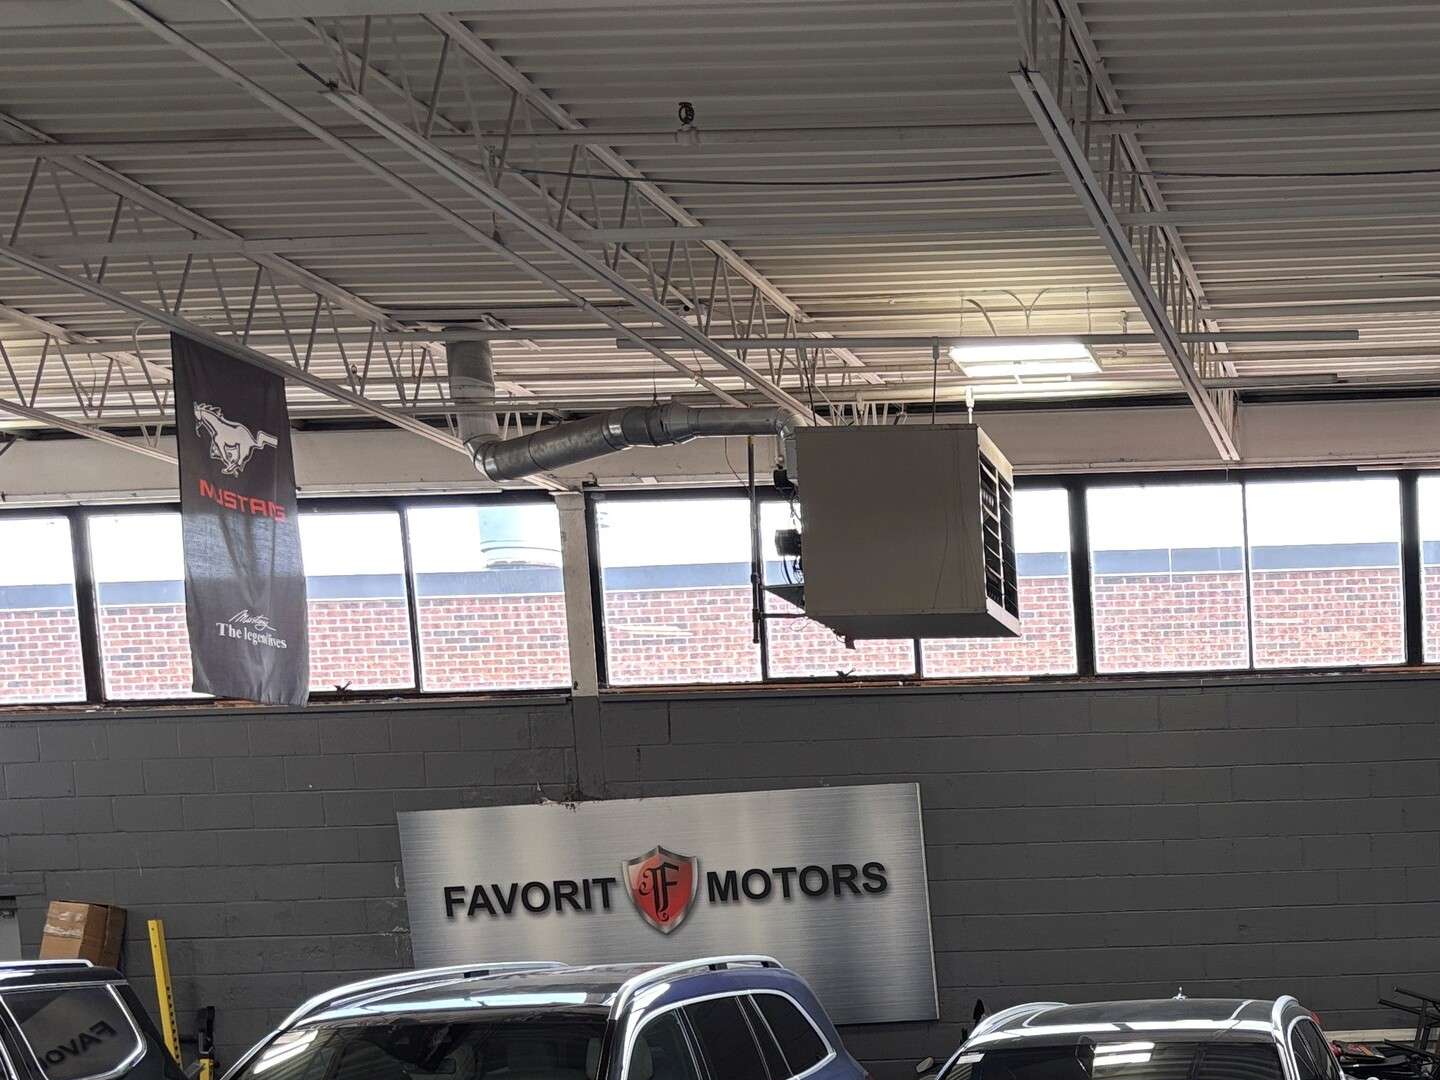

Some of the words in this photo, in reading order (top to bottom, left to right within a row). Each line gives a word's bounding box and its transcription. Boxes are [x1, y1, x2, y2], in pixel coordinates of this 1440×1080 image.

[215, 622, 243, 640] The
[443, 877, 616, 918] FAVORIT
[706, 861, 888, 903] MOTORS
